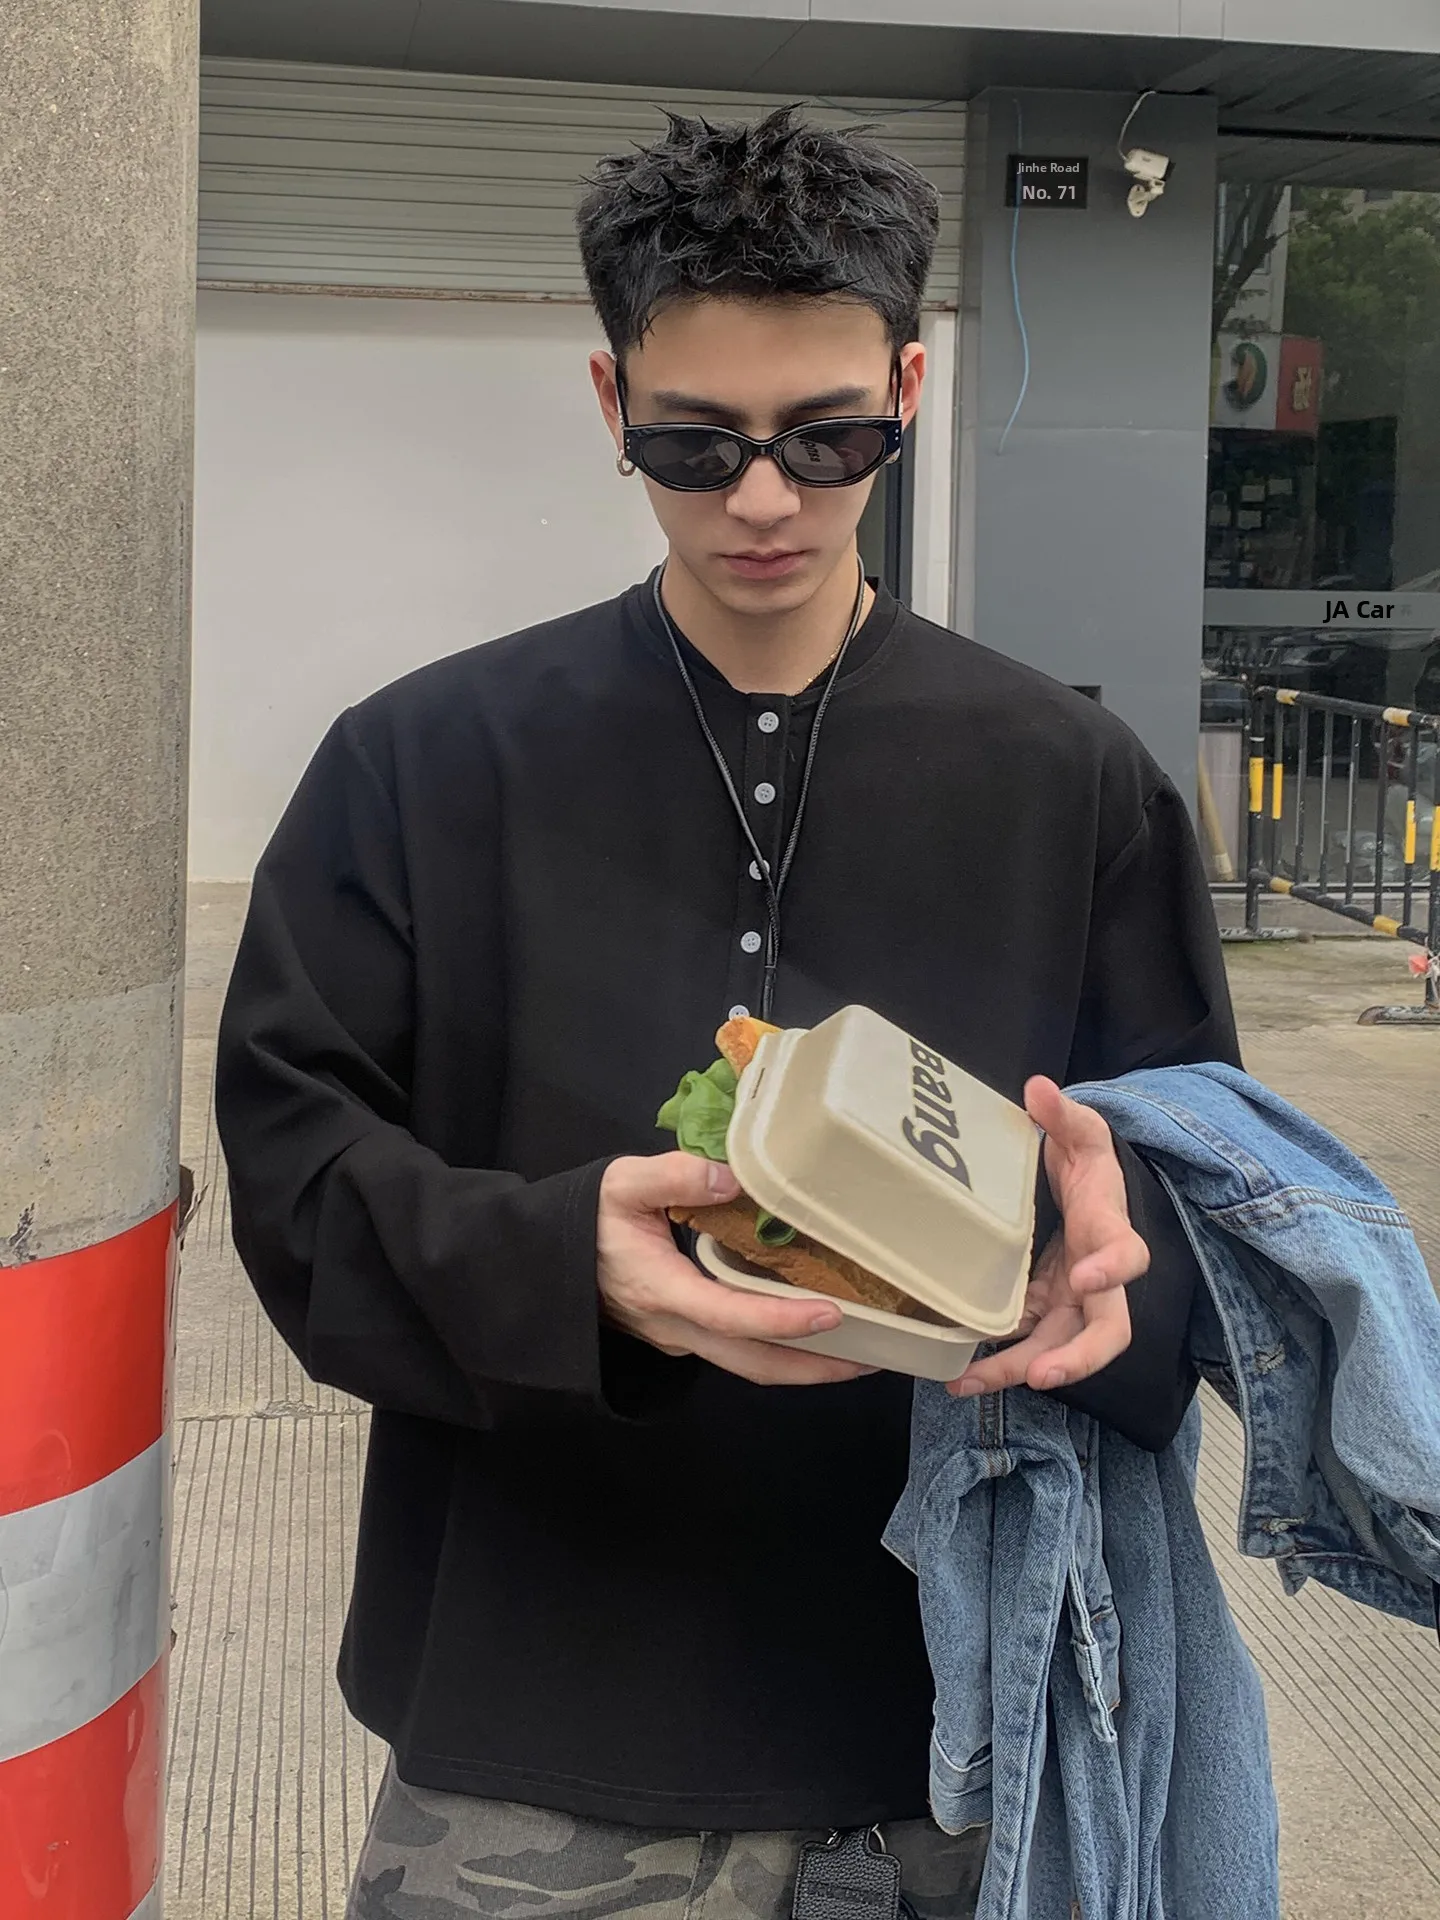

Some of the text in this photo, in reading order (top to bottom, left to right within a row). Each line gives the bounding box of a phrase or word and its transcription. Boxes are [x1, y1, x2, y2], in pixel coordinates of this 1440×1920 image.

[1017, 162, 1080, 174] Jinhe Road
[1022, 185, 1076, 200] No. 71
[1322, 600, 1350, 623] JA
[1356, 600, 1395, 619] Car
[902, 1038, 973, 1192] Bang
